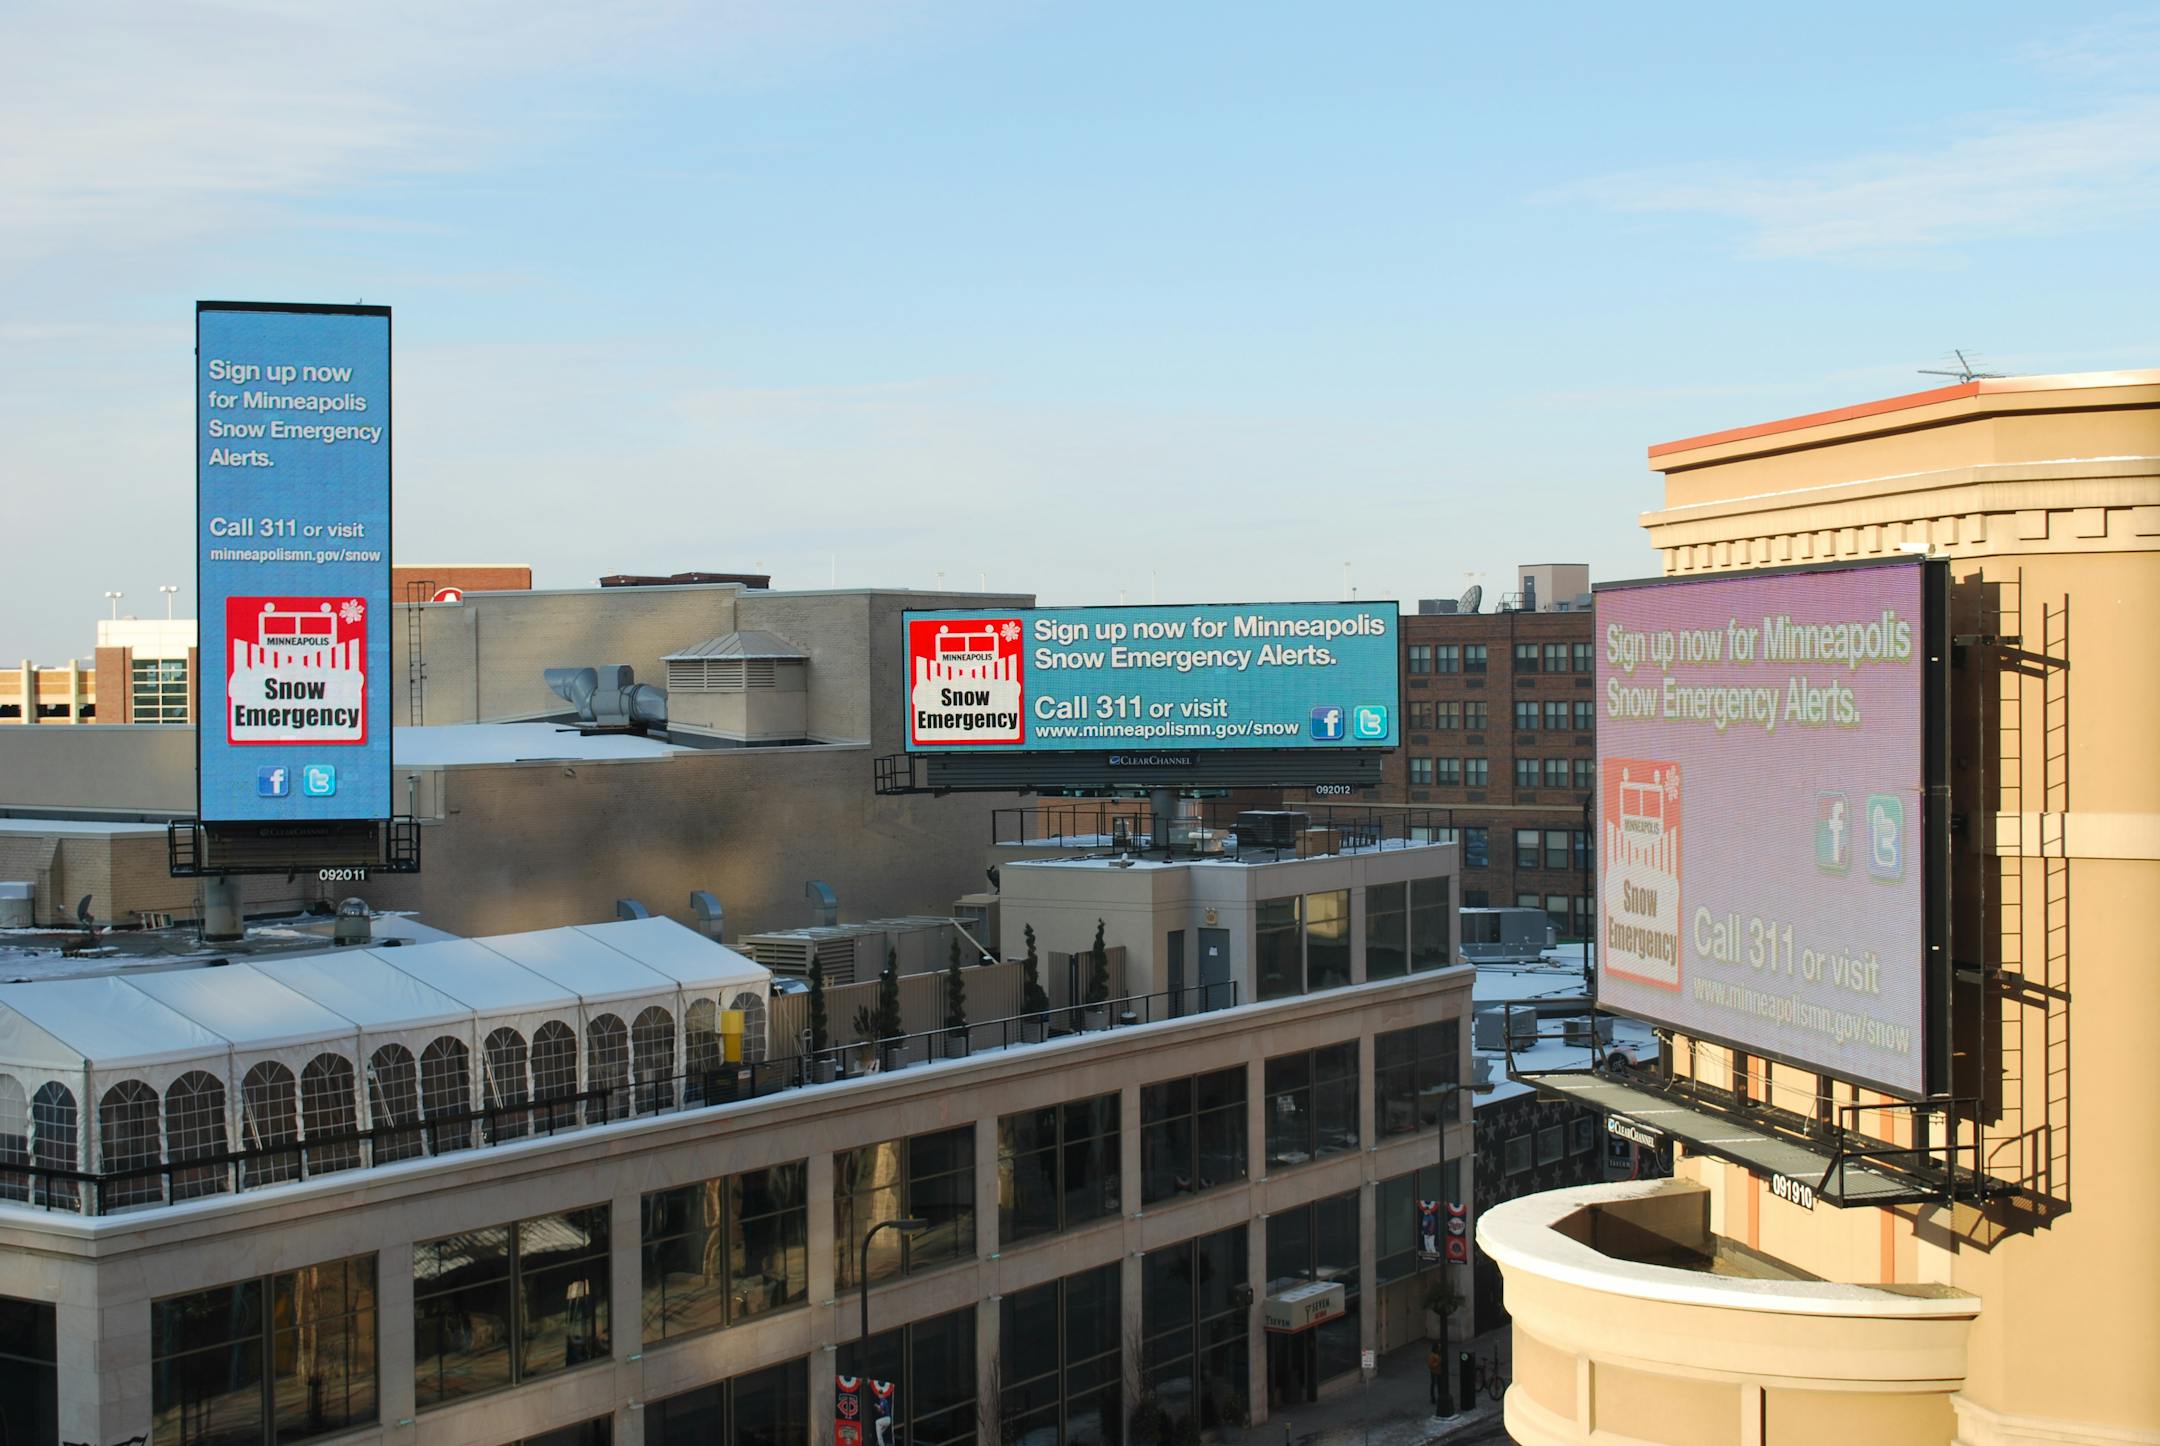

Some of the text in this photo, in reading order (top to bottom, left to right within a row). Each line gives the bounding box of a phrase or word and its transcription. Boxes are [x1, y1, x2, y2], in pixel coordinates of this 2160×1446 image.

[208, 359, 352, 385] Sign up now
[208, 391, 367, 413] for Minneapolis
[208, 419, 382, 443] Snow Emergency
[208, 448, 274, 466] Alerts.
[209, 517, 365, 538] Call 311 or visit
[210, 548, 381, 564] minneapolismn.gov/snow
[266, 636, 330, 646] MINNEAPOLIS
[1034, 614, 1385, 645] Sign up now for Minneapolis
[1606, 611, 1911, 672] Sign up now for Minneapolis
[942, 653, 993, 661] MINNEAPOLIS
[1034, 644, 1337, 672] Snow Emergency Alerts.
[264, 677, 326, 700] Snow
[941, 688, 990, 706] Snow
[1034, 695, 1228, 720] Call 311 or visit
[1606, 676, 1860, 730] Snow Emergency Alerts.
[235, 705, 359, 729] Emergency
[918, 711, 1017, 730] Emergency
[1035, 720, 1299, 739] www.minneapolismn.gov/snow
[1316, 785, 1350, 795] 092012
[1624, 818, 1660, 835] MINNEAPOLIS
[319, 869, 365, 881] 092011
[1623, 878, 1657, 918] Snow
[1608, 916, 1678, 966] Emergency
[1694, 906, 1880, 994] Call 311 or visit
[1694, 977, 1910, 1053] www.minneapolismn.gov/snow
[1772, 1173, 1813, 1210] 091910
